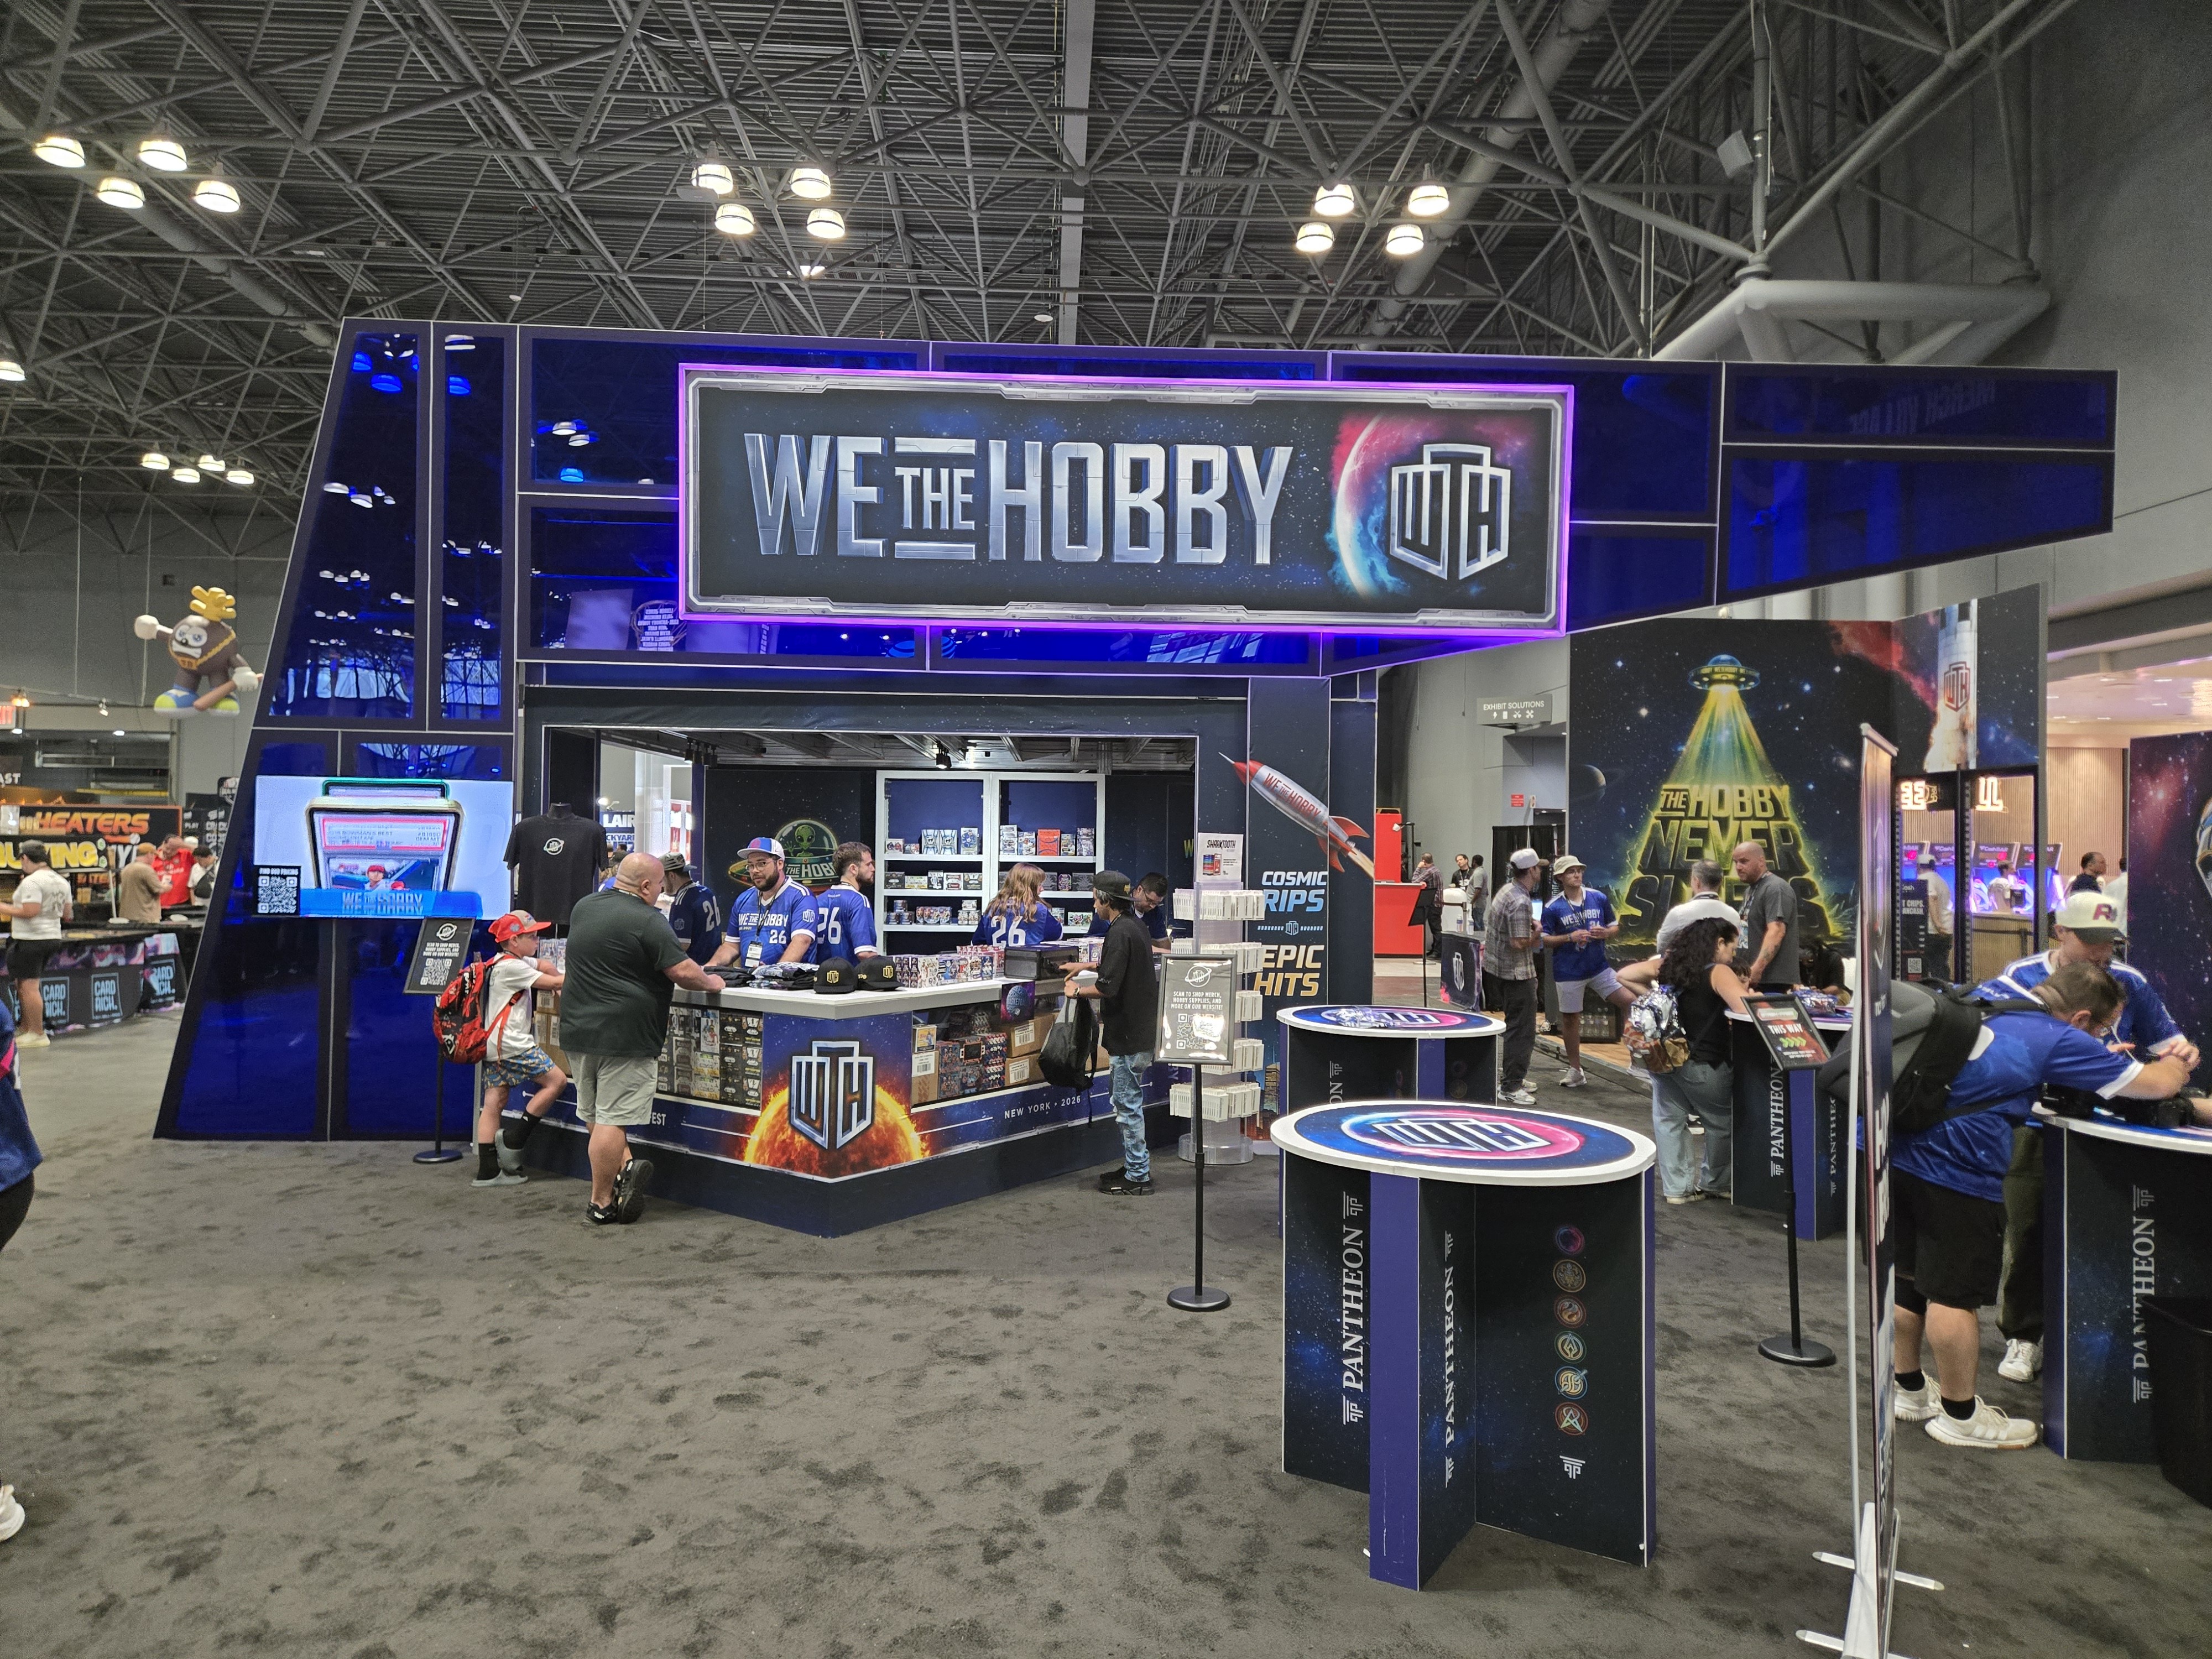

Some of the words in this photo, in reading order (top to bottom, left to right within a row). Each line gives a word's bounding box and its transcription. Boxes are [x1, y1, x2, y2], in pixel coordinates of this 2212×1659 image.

[744, 433, 885, 558] WE
[895, 466, 974, 531] THE
[987, 441, 1293, 565] HOBBY
[1508, 701, 1545, 709] SOLUTIONS
[1262, 773, 1282, 792] WE
[1279, 786, 1290, 797] THE
[1287, 790, 1322, 821] HOBBY
[1660, 790, 1688, 808] THE
[1688, 784, 1790, 818] HOBBY
[35, 811, 150, 834] HEATERS
[0, 841, 98, 871] UING
[1207, 839, 1237, 850] SHARKTOOTH
[1640, 820, 1810, 872] NEVER
[786, 867, 800, 875] THE
[1261, 871, 1328, 886] COSMIC
[1263, 889, 1326, 912] RIPS
[702, 895, 721, 932] 26
[738, 914, 749, 925] WE
[1561, 915, 1573, 926] WE
[769, 930, 787, 944] 26
[991, 915, 1026, 949] 26
[1261, 945, 1324, 968] EPIC
[156, 966, 174, 980] ARD
[1254, 972, 1320, 997] HITS
[43, 984, 66, 1001] CARD
[95, 980, 116, 996] CARD
[95, 996, 118, 1011] RICH.
[1767, 1024, 1786, 1035] THIS
[1785, 1024, 1803, 1033] WAY
[1004, 1107, 1024, 1119] NEW
[1027, 1102, 1051, 1114] YORK
[1061, 1095, 1081, 1107] 2026
[1343, 1224, 1363, 1393] PANTHEON
[1444, 1266, 1455, 1449] PANTHEON
